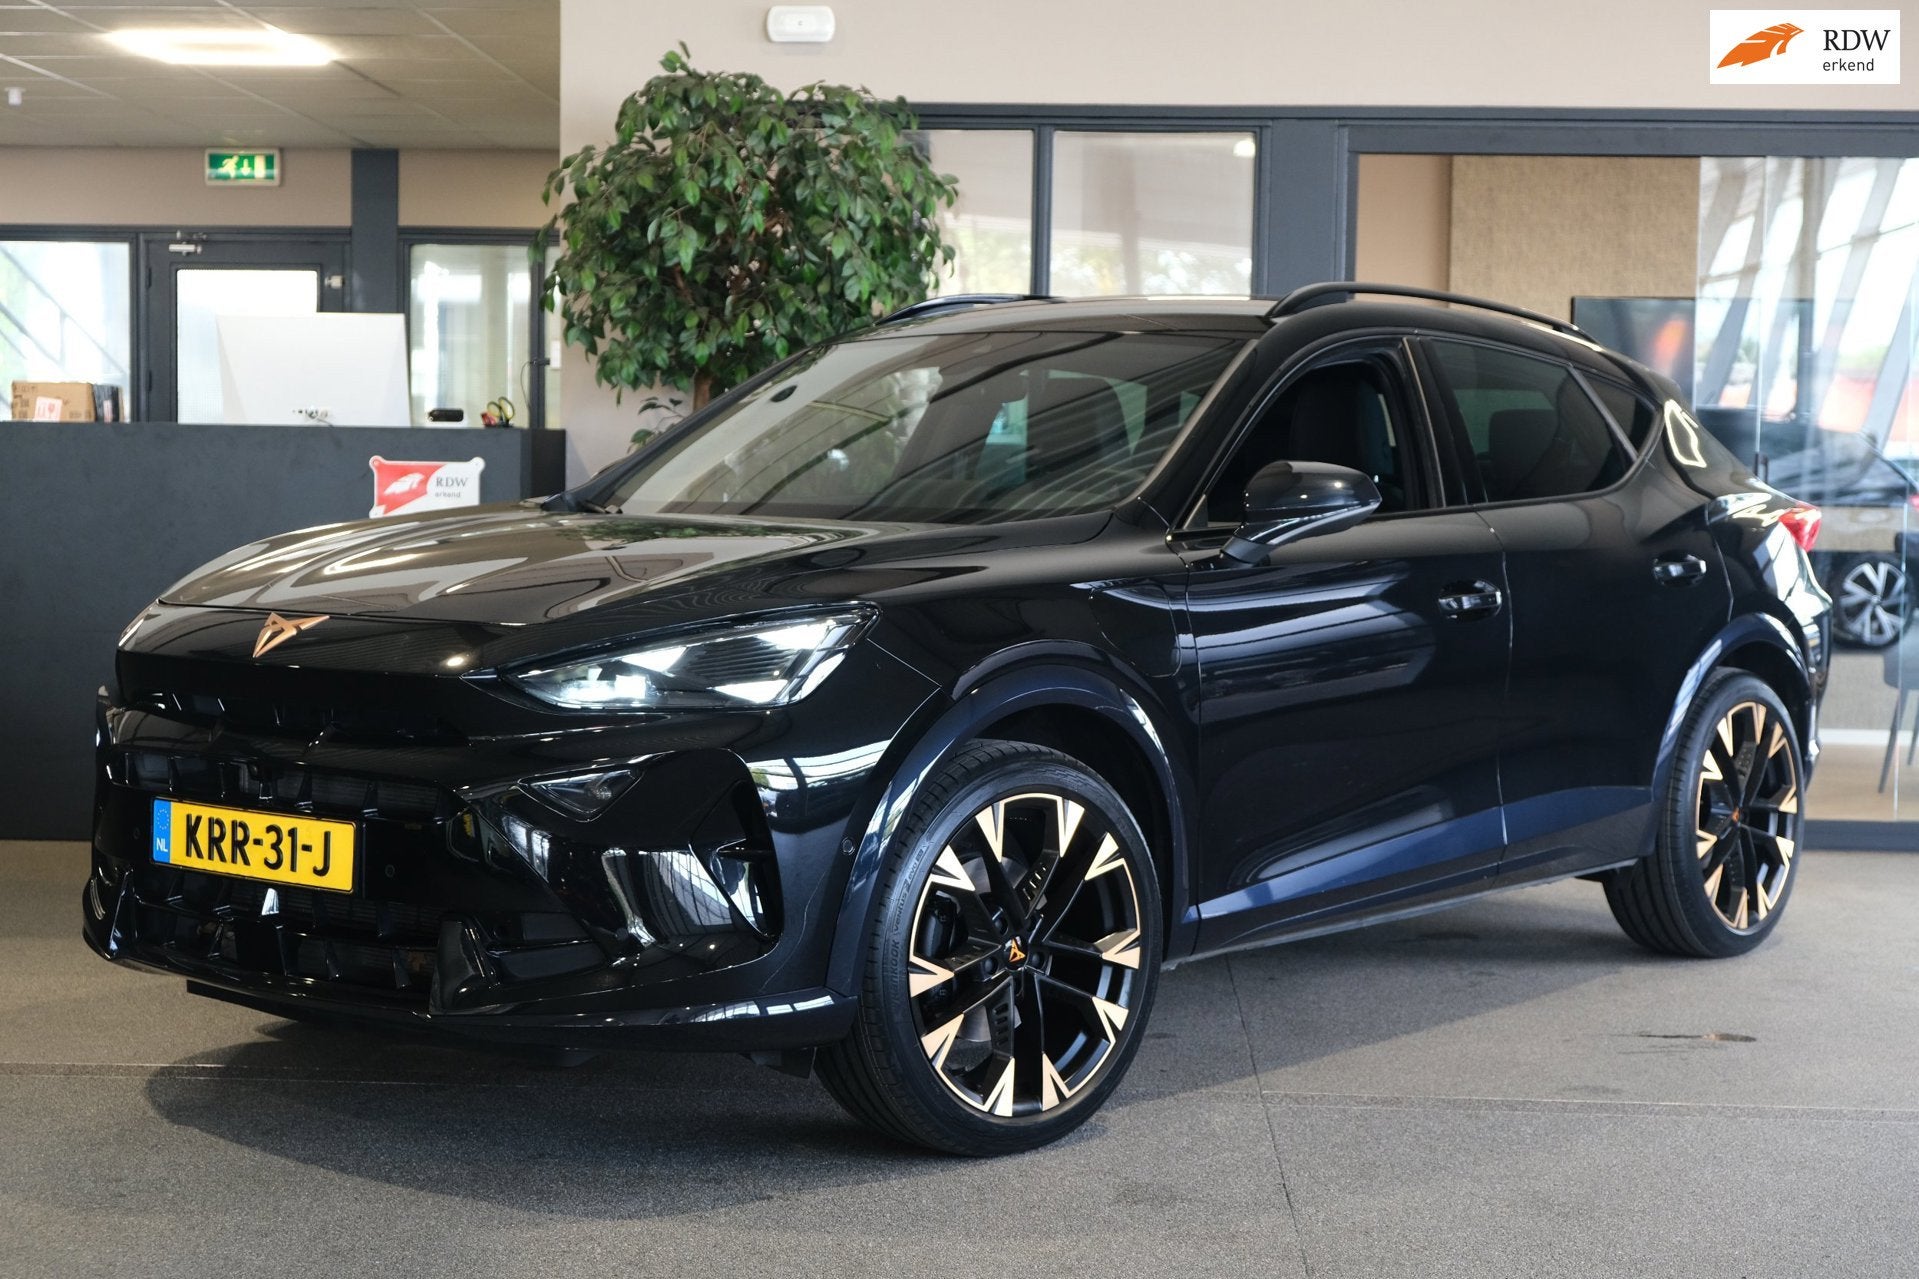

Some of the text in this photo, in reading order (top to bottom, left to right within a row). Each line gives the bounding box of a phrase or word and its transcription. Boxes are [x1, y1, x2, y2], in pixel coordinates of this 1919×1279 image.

[436, 477, 468, 487] RDW
[156, 838, 169, 853] NL
[185, 813, 332, 877] KRR-31-J
